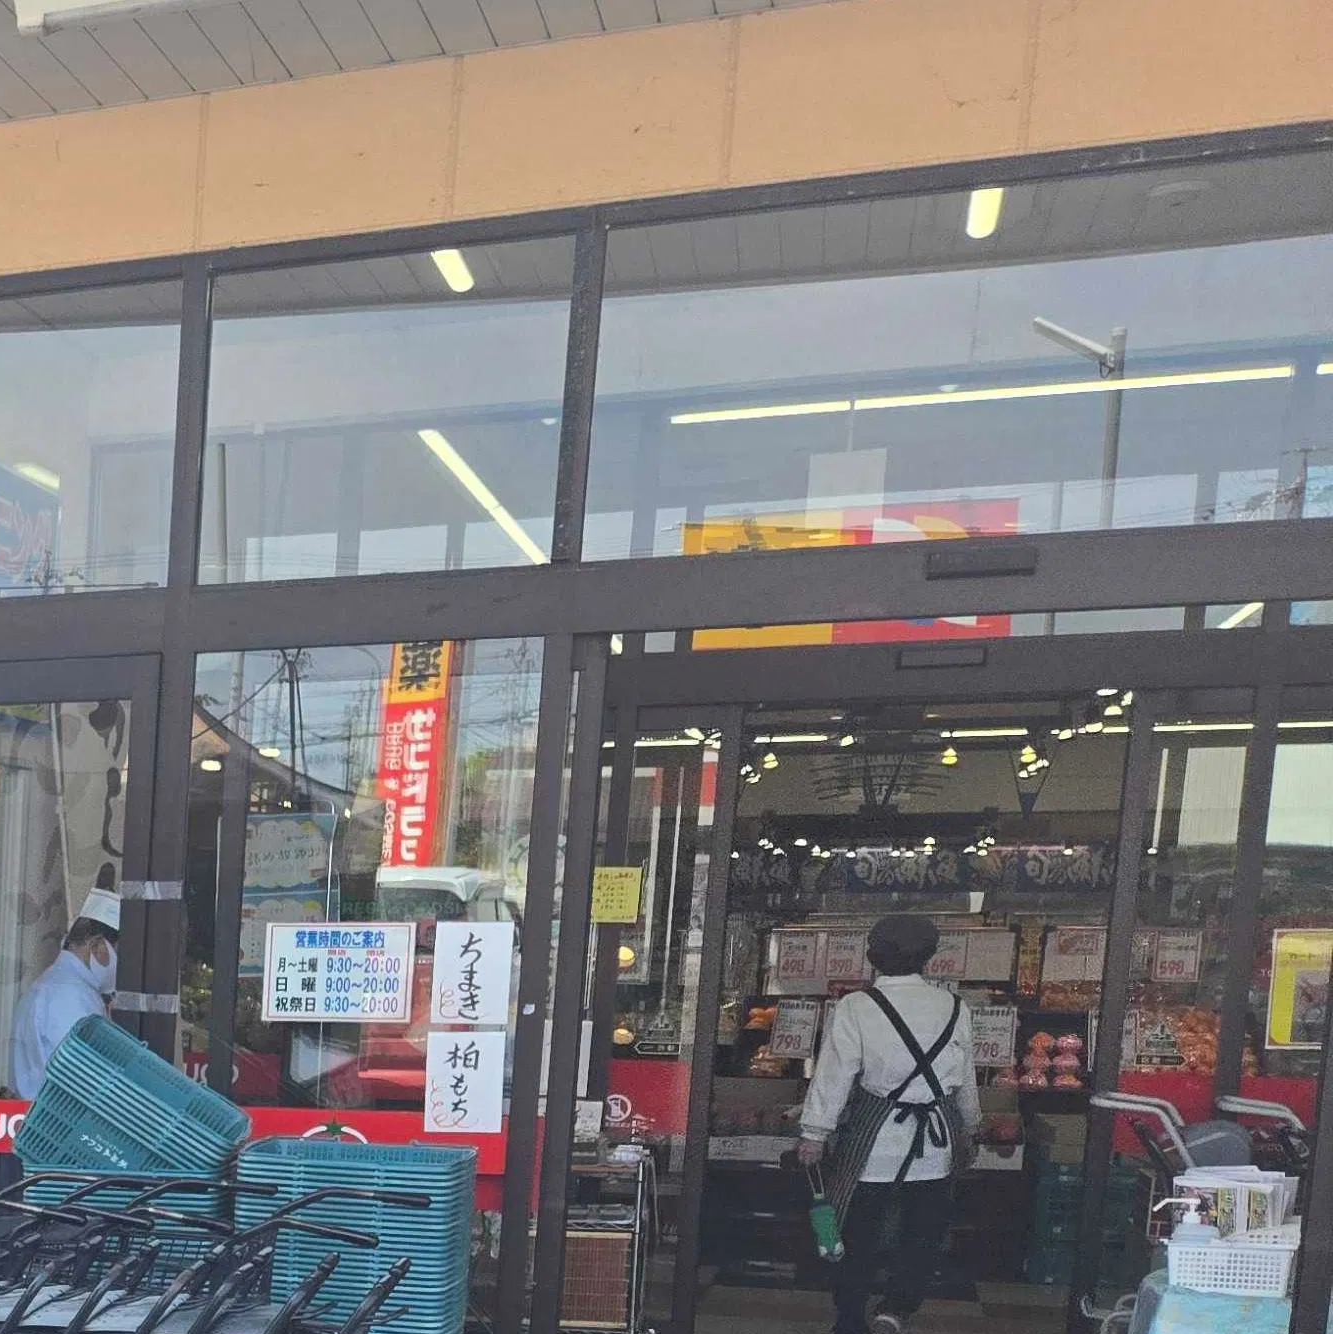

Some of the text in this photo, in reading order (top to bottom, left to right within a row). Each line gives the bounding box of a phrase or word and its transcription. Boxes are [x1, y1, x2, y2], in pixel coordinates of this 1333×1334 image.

[295, 930, 385, 948] 営業時間のご案内
[457, 933, 485, 1021] ちまき
[275, 997, 316, 1013] 祝祭日
[444, 1042, 480, 1119] 柏もち
